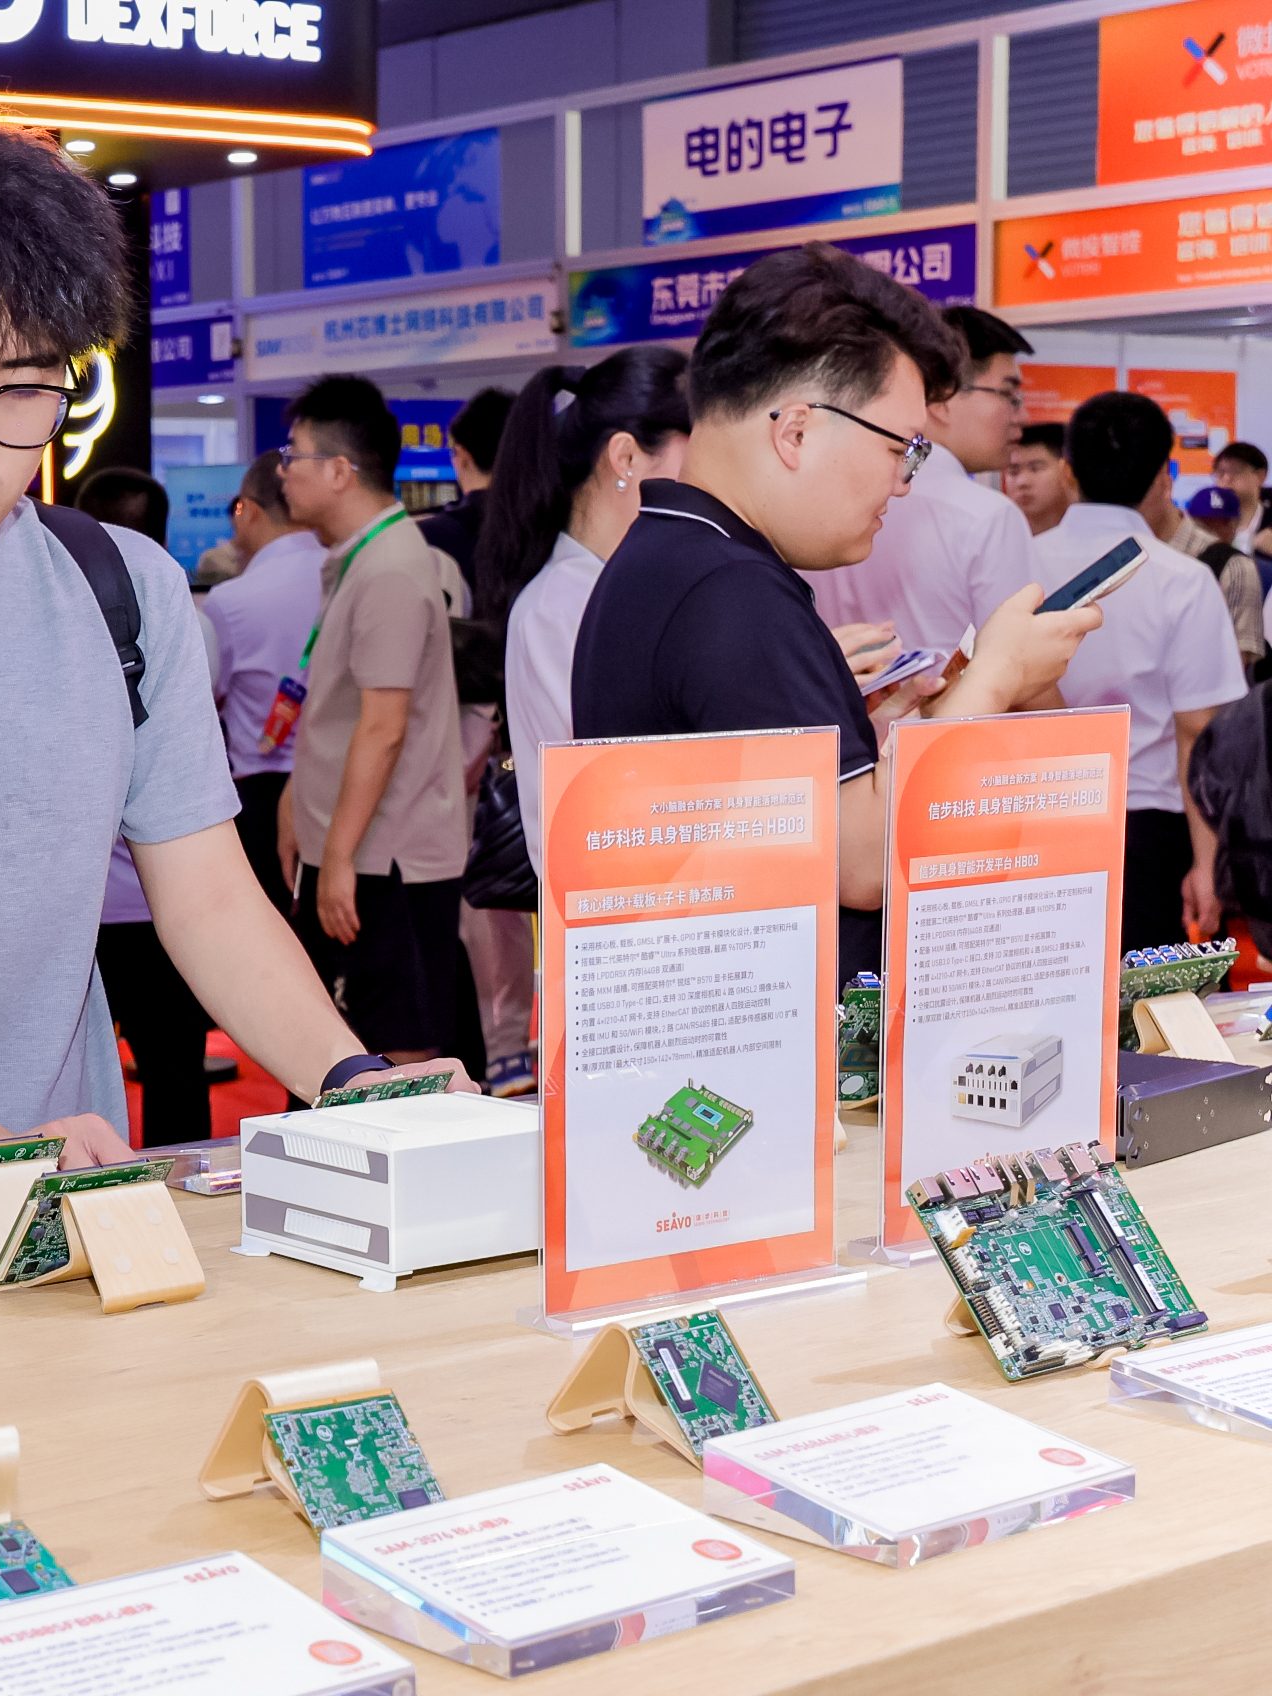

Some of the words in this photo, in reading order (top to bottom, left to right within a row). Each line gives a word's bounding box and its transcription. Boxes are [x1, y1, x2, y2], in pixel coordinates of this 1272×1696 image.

[65, 0, 323, 63] DEXFORCE
[685, 100, 853, 178] 电的电子
[928, 800, 976, 822] 信步科技
[978, 792, 1068, 816] 具身智能开发平台
[1071, 789, 1102, 807] HB03
[585, 826, 646, 851] 信步科技
[648, 817, 764, 846] 具身智能开发平台
[766, 814, 805, 836] HB03
[919, 856, 1013, 880] 信步具身智能开发平台
[1014, 853, 1040, 870] HB03
[577, 889, 687, 915] 核心模块+载板+子卡
[688, 885, 735, 904] 静态展示
[580, 971, 595, 982] 支持
[581, 1016, 595, 1028] 内置
